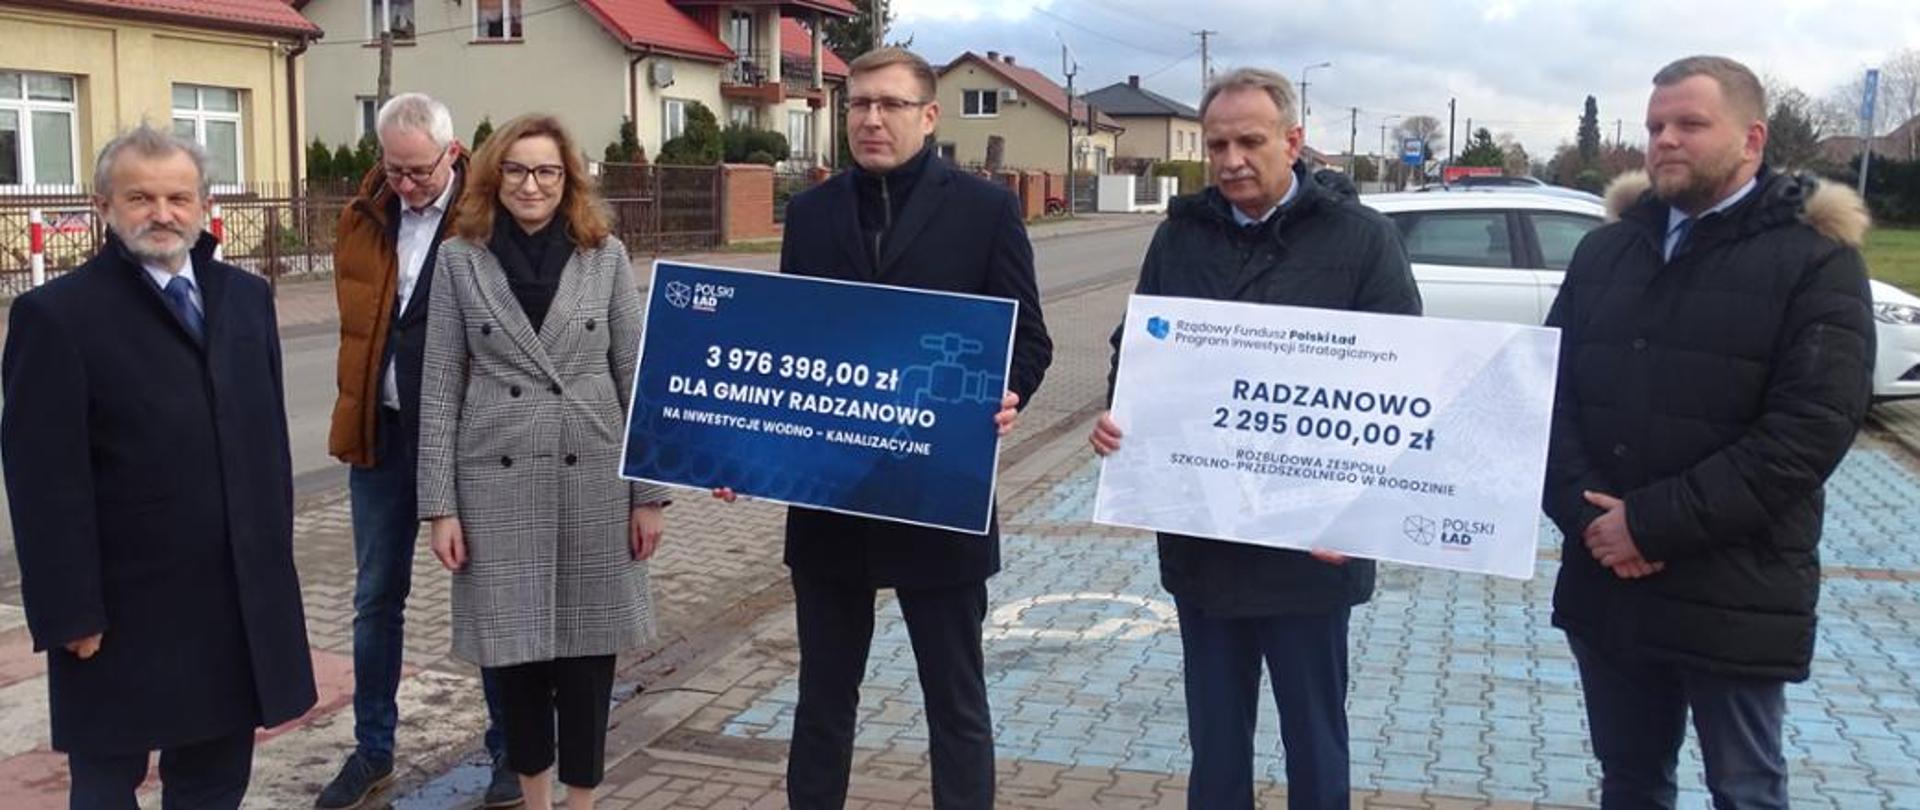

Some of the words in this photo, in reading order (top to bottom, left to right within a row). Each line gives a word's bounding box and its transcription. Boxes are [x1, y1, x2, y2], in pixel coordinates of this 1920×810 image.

[694, 282, 735, 299] POLSKI
[1175, 331, 1230, 347] Program
[1231, 338, 1296, 354] Inwestycji
[1298, 343, 1398, 363] Strategicznych
[1176, 319, 1233, 336] Rządowy
[1233, 323, 1287, 340] Fundusz
[1289, 329, 1330, 343] Polski
[706, 345, 722, 368] 3
[728, 348, 773, 375] 976
[779, 354, 870, 387] 398,00
[875, 368, 899, 392] zł
[668, 374, 708, 397] DLA
[713, 382, 785, 408] GMINY
[788, 391, 936, 428] RADZANOWO
[1232, 379, 1432, 418] RADZANOWO
[662, 406, 681, 420] NA
[683, 408, 761, 432] INWESTYCJE
[762, 420, 814, 439] WODNO
[825, 430, 932, 456] KANALIZACYJNE
[1213, 407, 1230, 428] 2
[1236, 409, 1288, 434] 295
[1296, 415, 1401, 447] 000,00
[1408, 428, 1435, 451] zł
[1170, 453, 1357, 483] SZKOLNO-PRZEDSZKOLNEGO
[1361, 474, 1374, 486] W
[1378, 476, 1457, 496] ROGOZINIE
[1236, 449, 1322, 467] ROZBUDOWA
[1443, 518, 1495, 535] POLSKI
